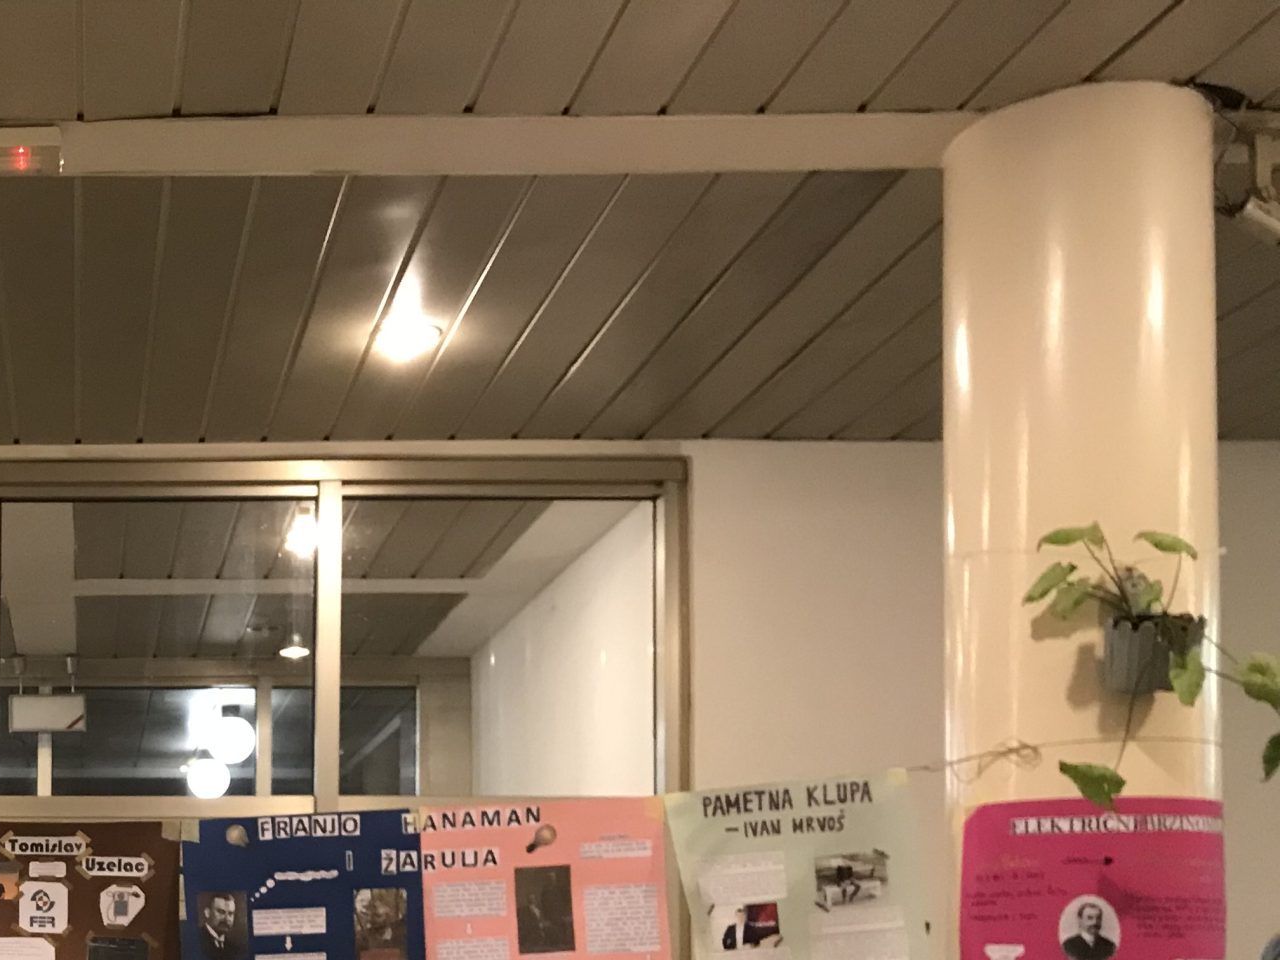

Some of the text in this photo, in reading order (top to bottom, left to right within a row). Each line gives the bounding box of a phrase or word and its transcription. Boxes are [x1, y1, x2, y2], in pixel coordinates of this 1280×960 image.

[702, 780, 873, 818] PAMETNA KLUPA
[260, 806, 541, 838] FRANJO HANAMAN
[744, 819, 782, 838] IVAN
[8, 838, 82, 853] Tomislav
[85, 857, 145, 873] Uzelac
